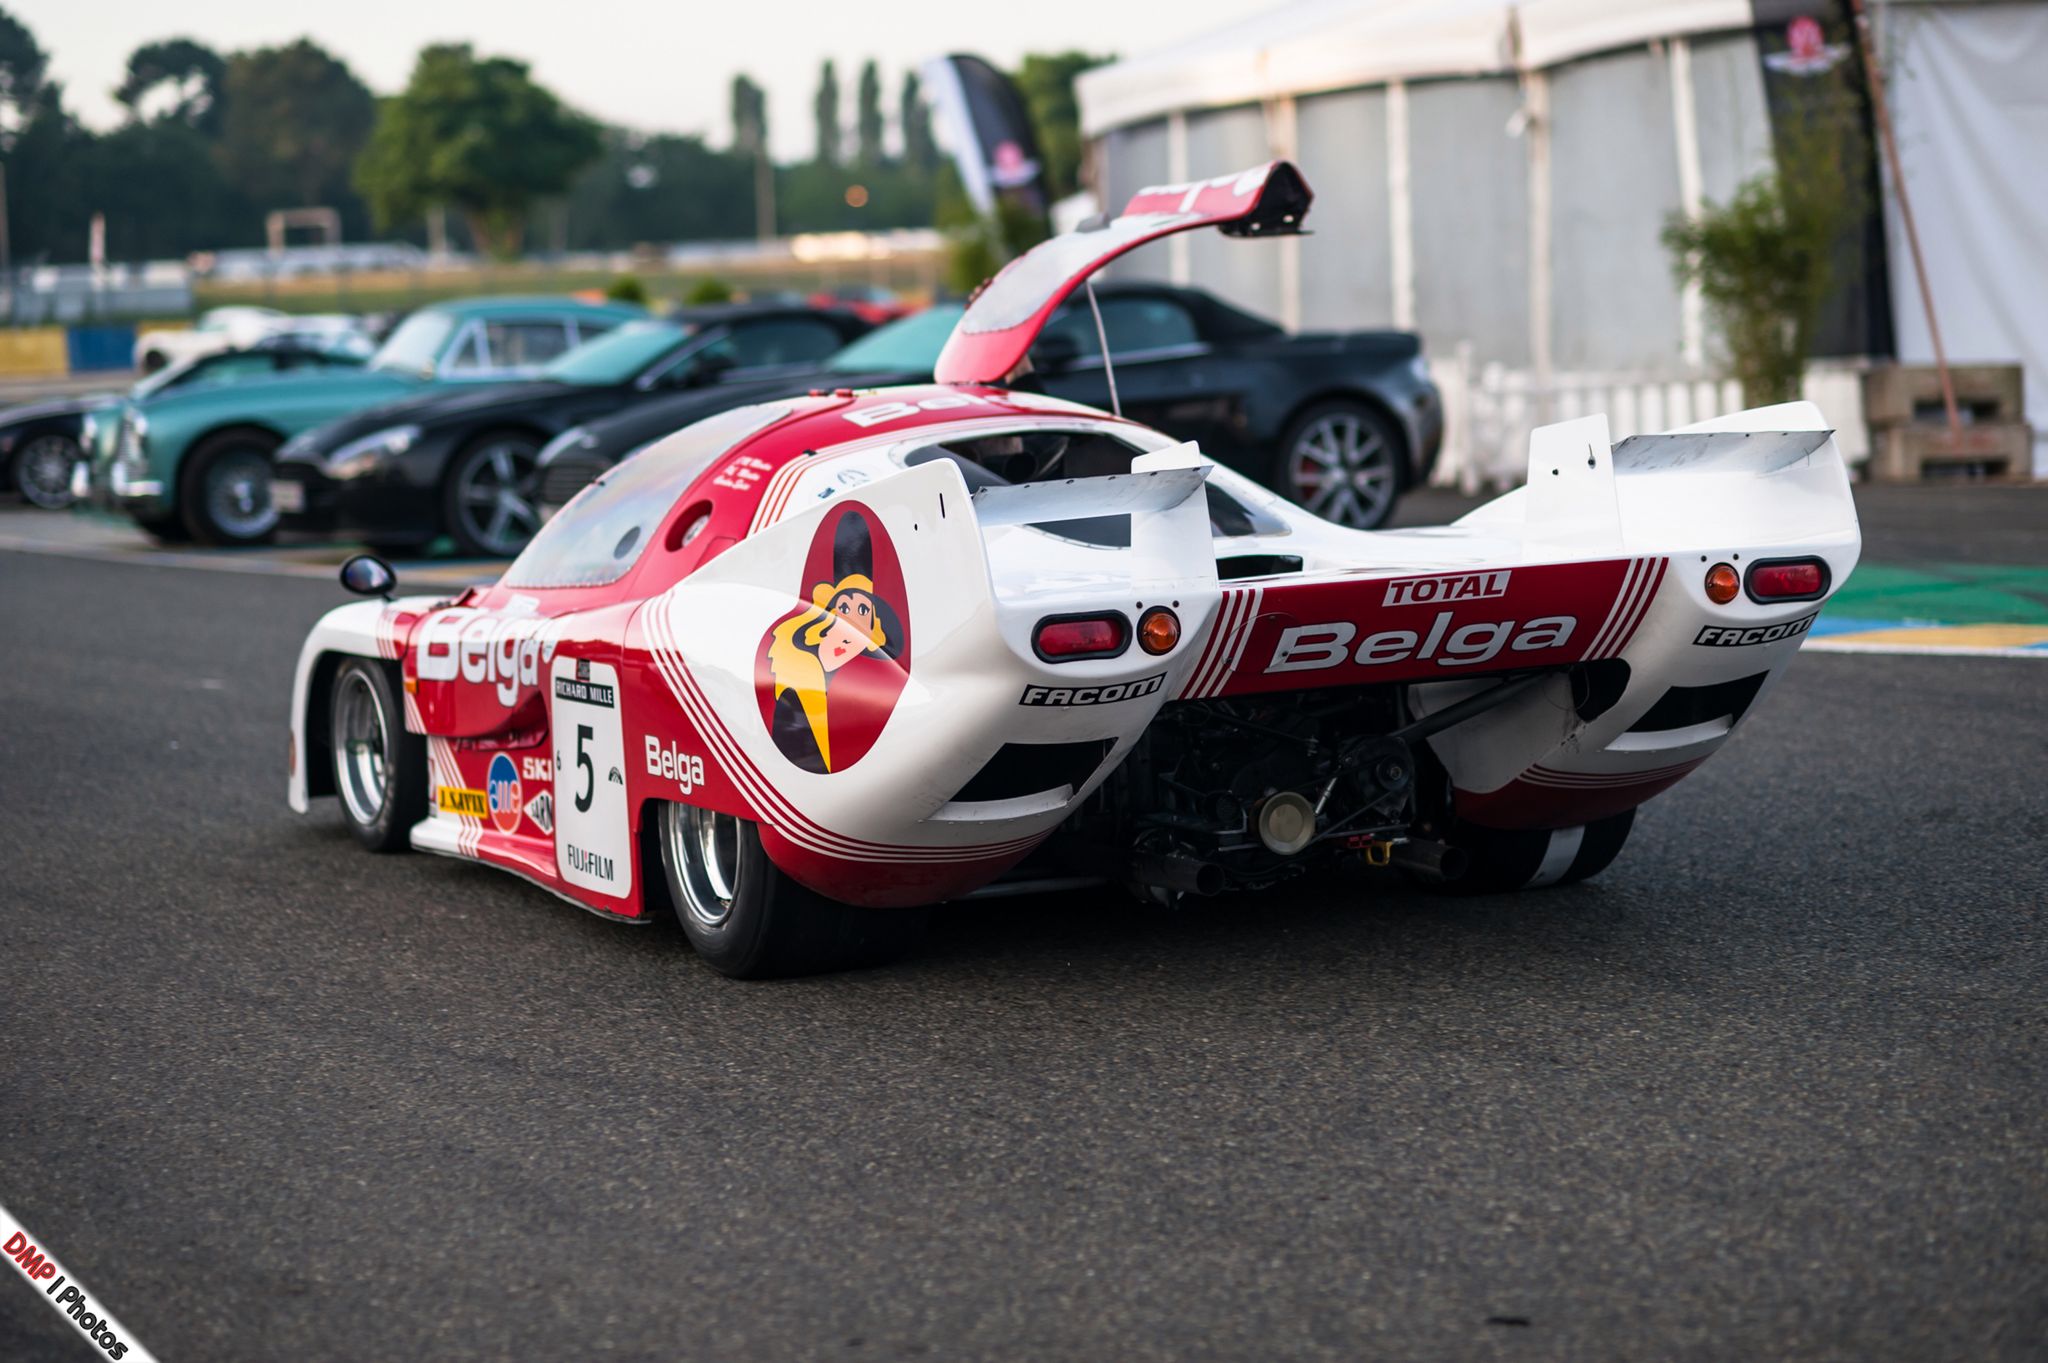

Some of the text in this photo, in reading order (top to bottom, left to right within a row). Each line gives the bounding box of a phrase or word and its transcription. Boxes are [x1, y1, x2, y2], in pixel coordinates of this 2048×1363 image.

[1390, 574, 1504, 603] TOTAL
[1263, 611, 1578, 674] Belga
[1697, 614, 1816, 645] FACOM
[417, 607, 541, 708] Belga
[556, 680, 613, 704] RICHARD MILLE
[1023, 675, 1164, 705] FACOM
[574, 724, 594, 813] 5
[645, 735, 705, 795] Belga
[567, 844, 614, 881] FUJIFILM
